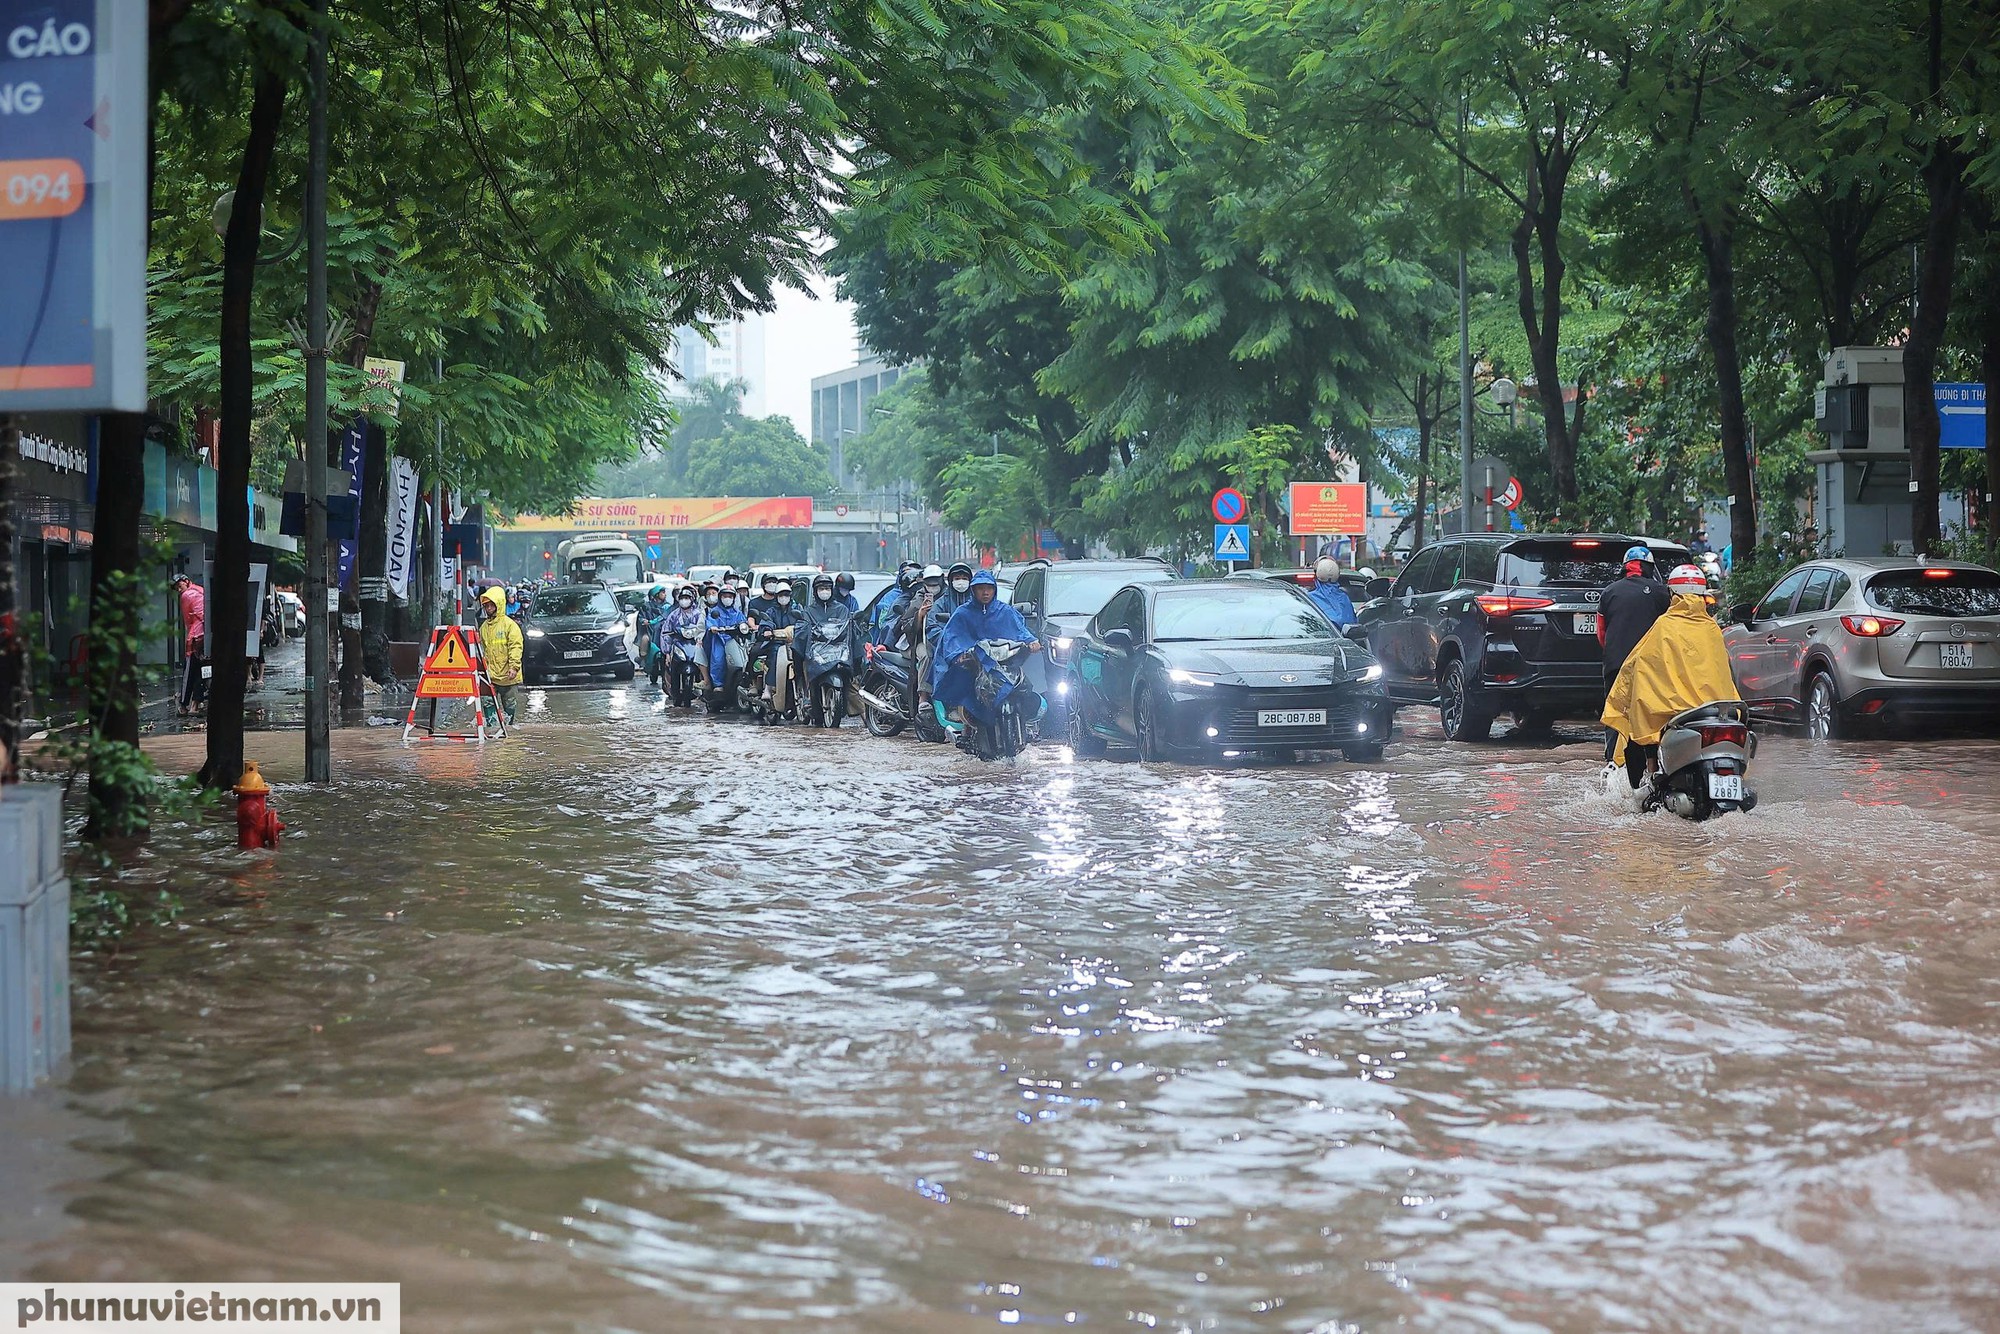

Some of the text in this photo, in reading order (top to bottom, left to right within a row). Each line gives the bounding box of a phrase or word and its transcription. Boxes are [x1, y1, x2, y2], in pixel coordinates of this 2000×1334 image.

[7, 17, 91, 58] CÁO
[7, 172, 71, 204] 094
[1961, 389, 1969, 400] ĐI
[670, 514, 689, 526] TIM
[388, 474, 410, 582] HYUNDAI
[1948, 645, 1966, 656] 51A
[1942, 656, 1972, 667] 780.47
[1264, 713, 1321, 724] 28C-087.88
[1714, 787, 1738, 799] 2887
